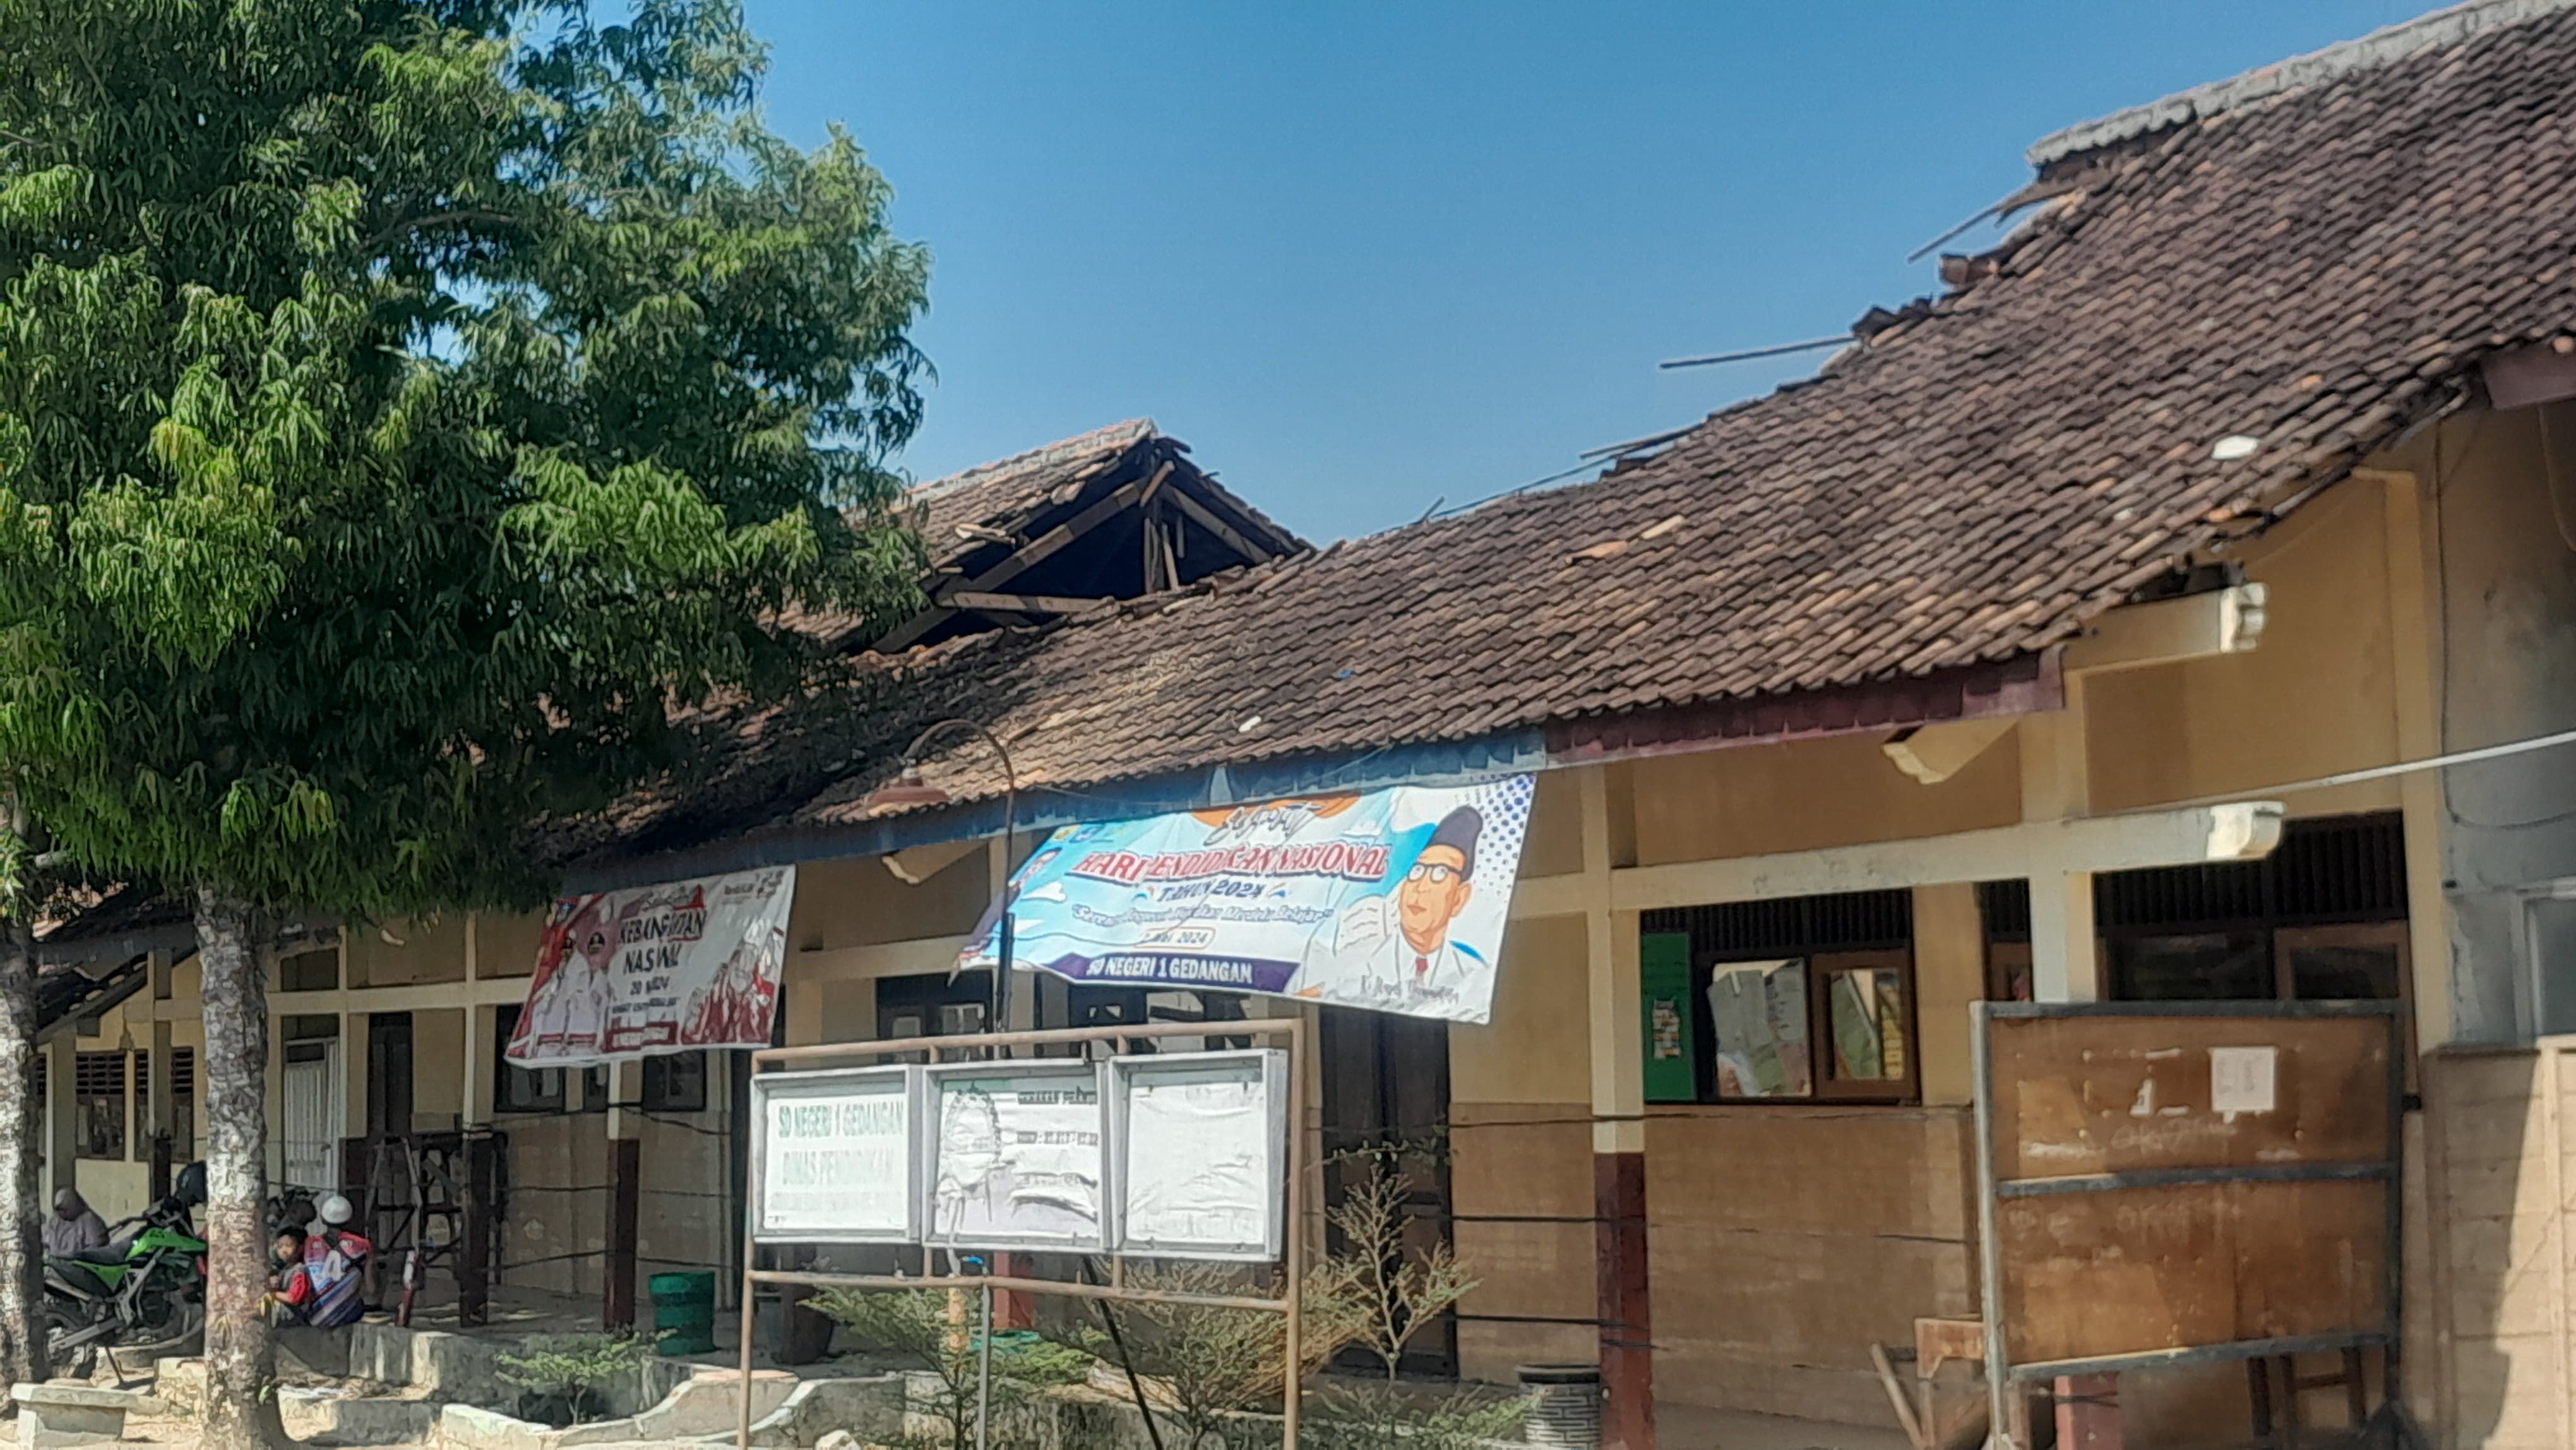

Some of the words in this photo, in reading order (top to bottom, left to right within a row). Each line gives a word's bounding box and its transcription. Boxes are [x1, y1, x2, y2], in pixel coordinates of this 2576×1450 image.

[1067, 849, 1150, 885] HARI
[1210, 878, 1264, 898] 2024
[1106, 956, 1157, 977] NEGERI
[1157, 957, 1167, 978] 1
[1169, 957, 1253, 984] GEDANGAN
[778, 1105, 792, 1138] SD
[794, 1105, 833, 1138] NEGERI
[842, 1101, 904, 1137] GEDANGAN
